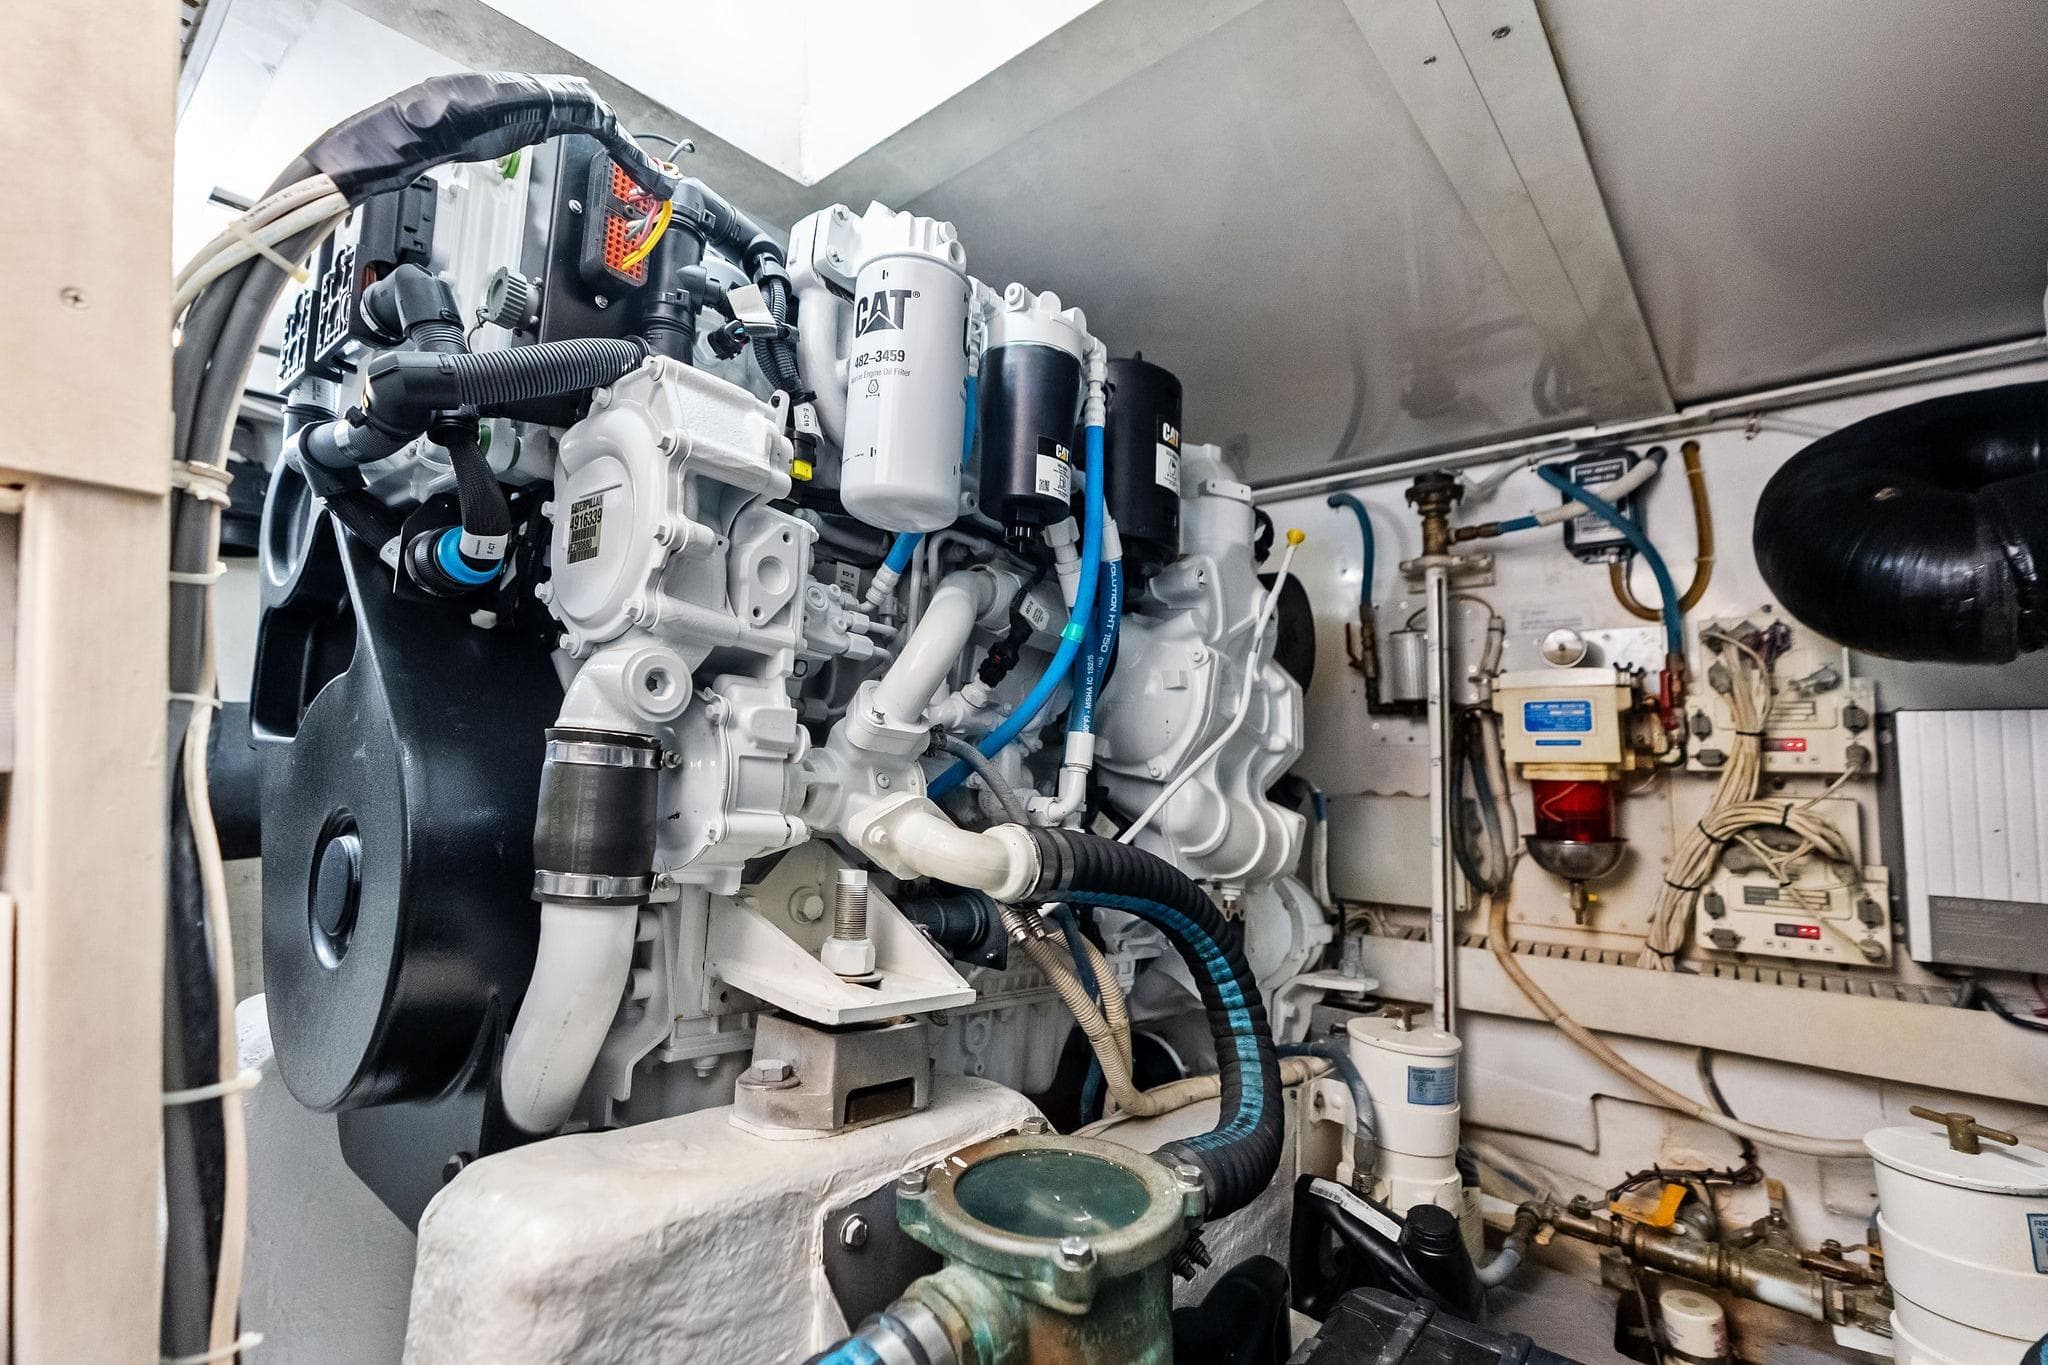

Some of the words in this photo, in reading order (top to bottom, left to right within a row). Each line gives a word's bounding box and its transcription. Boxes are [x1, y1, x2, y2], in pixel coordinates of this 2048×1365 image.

[855, 350, 905, 368] 482-3459
[1163, 422, 1179, 448] CAT
[1106, 613, 1116, 631] HT
[1100, 632, 1112, 653] 150
[1084, 687, 1093, 709] MSHA
